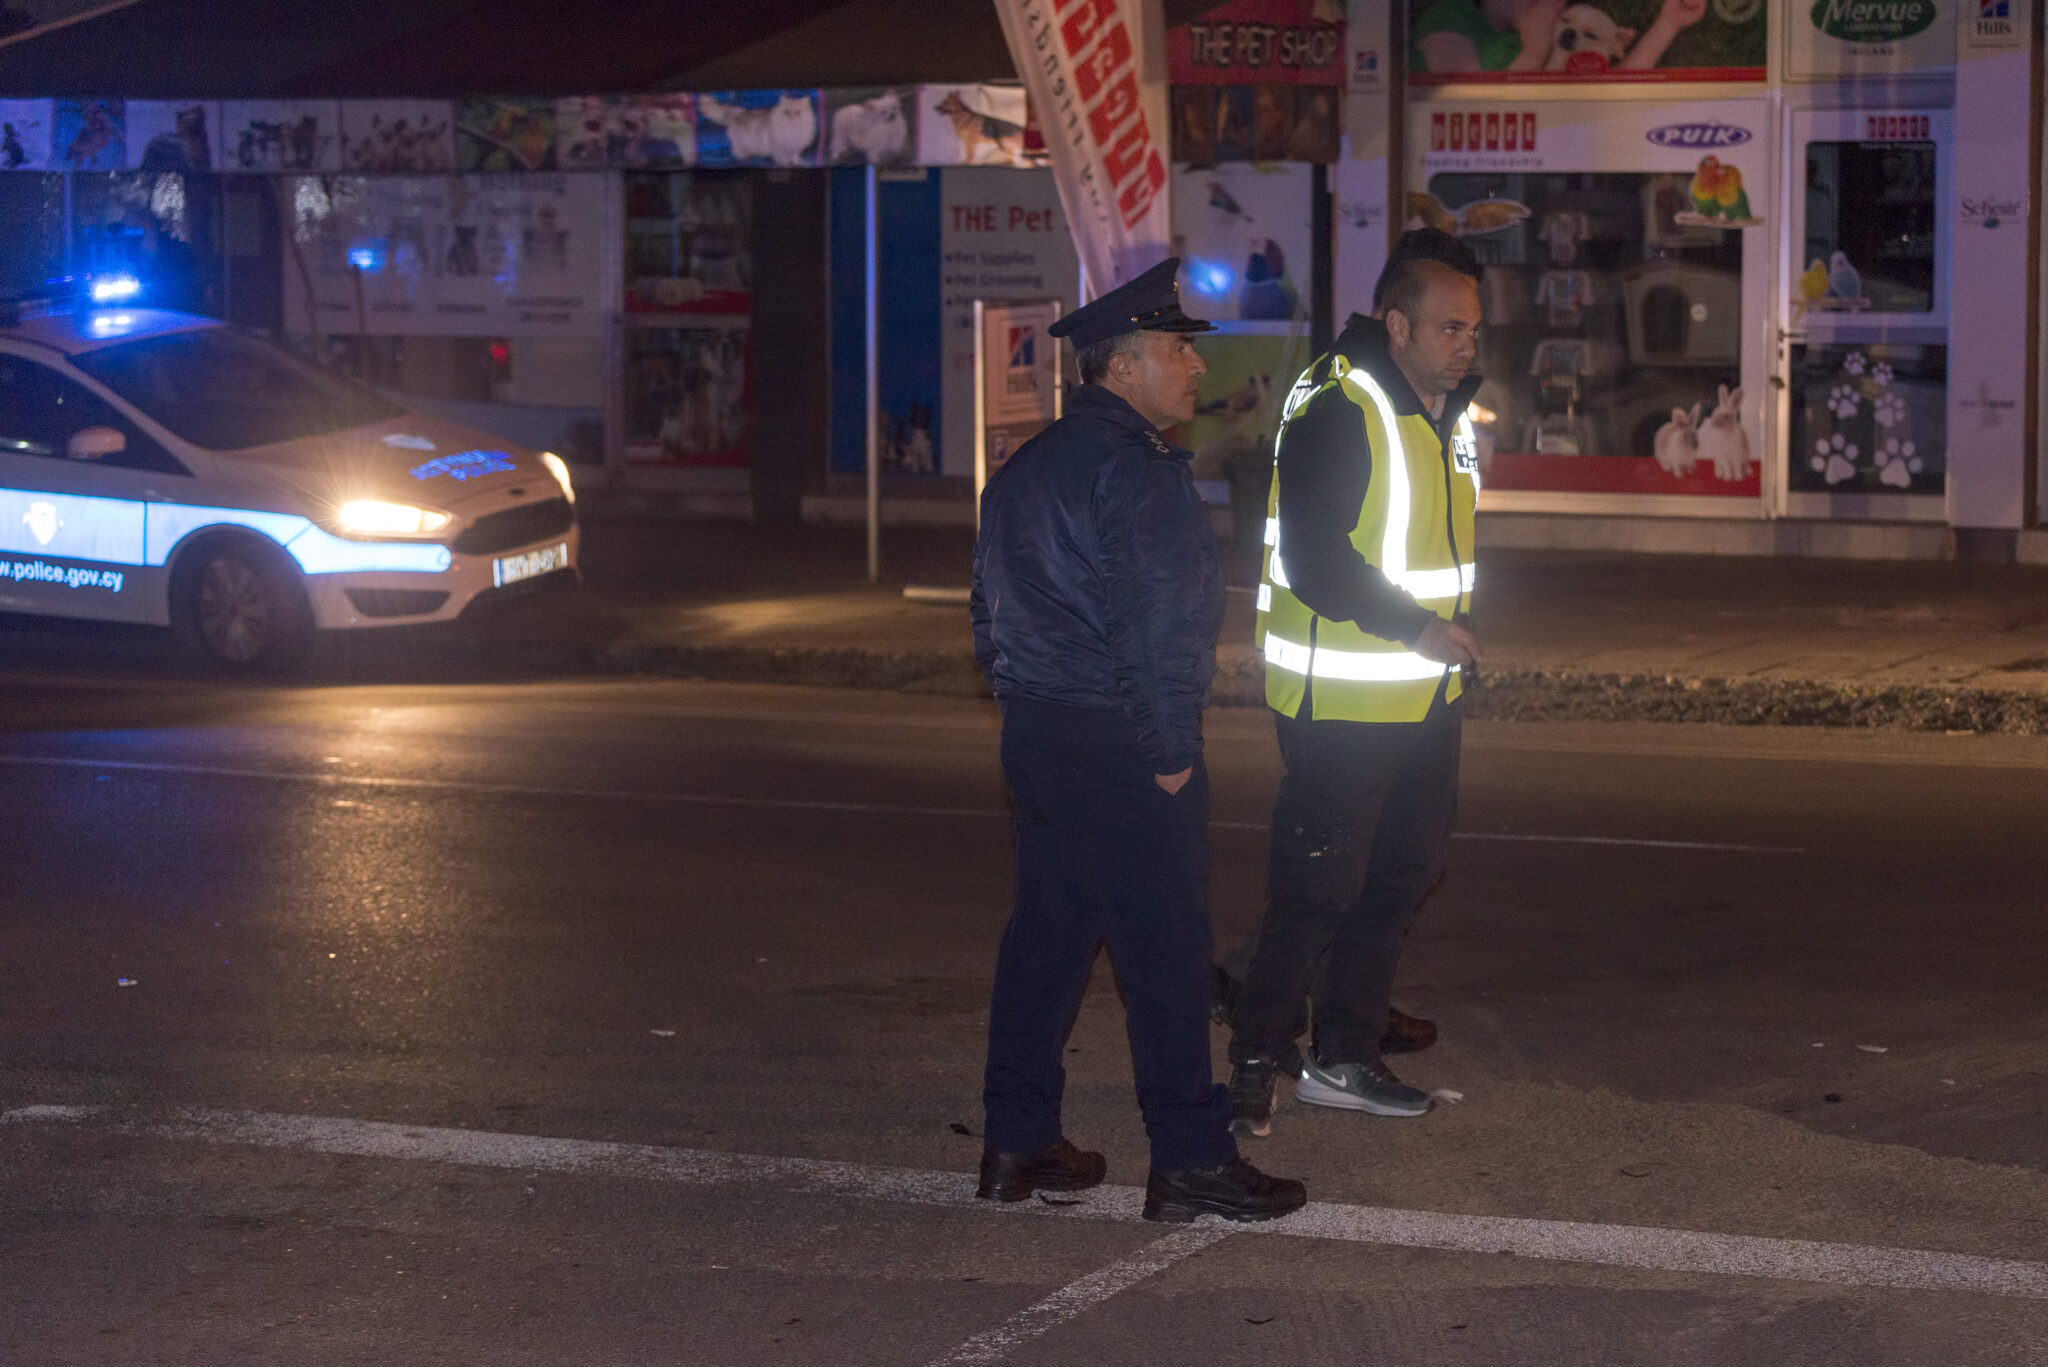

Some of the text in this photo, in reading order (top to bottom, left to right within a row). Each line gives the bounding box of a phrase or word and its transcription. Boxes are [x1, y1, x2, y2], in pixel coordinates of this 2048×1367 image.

[1820, 0, 1923, 28] Mervue
[1189, 25, 1338, 67] THE PET SHOP
[1663, 126, 1732, 144] PUIK
[951, 205, 1054, 232] THE Pet
